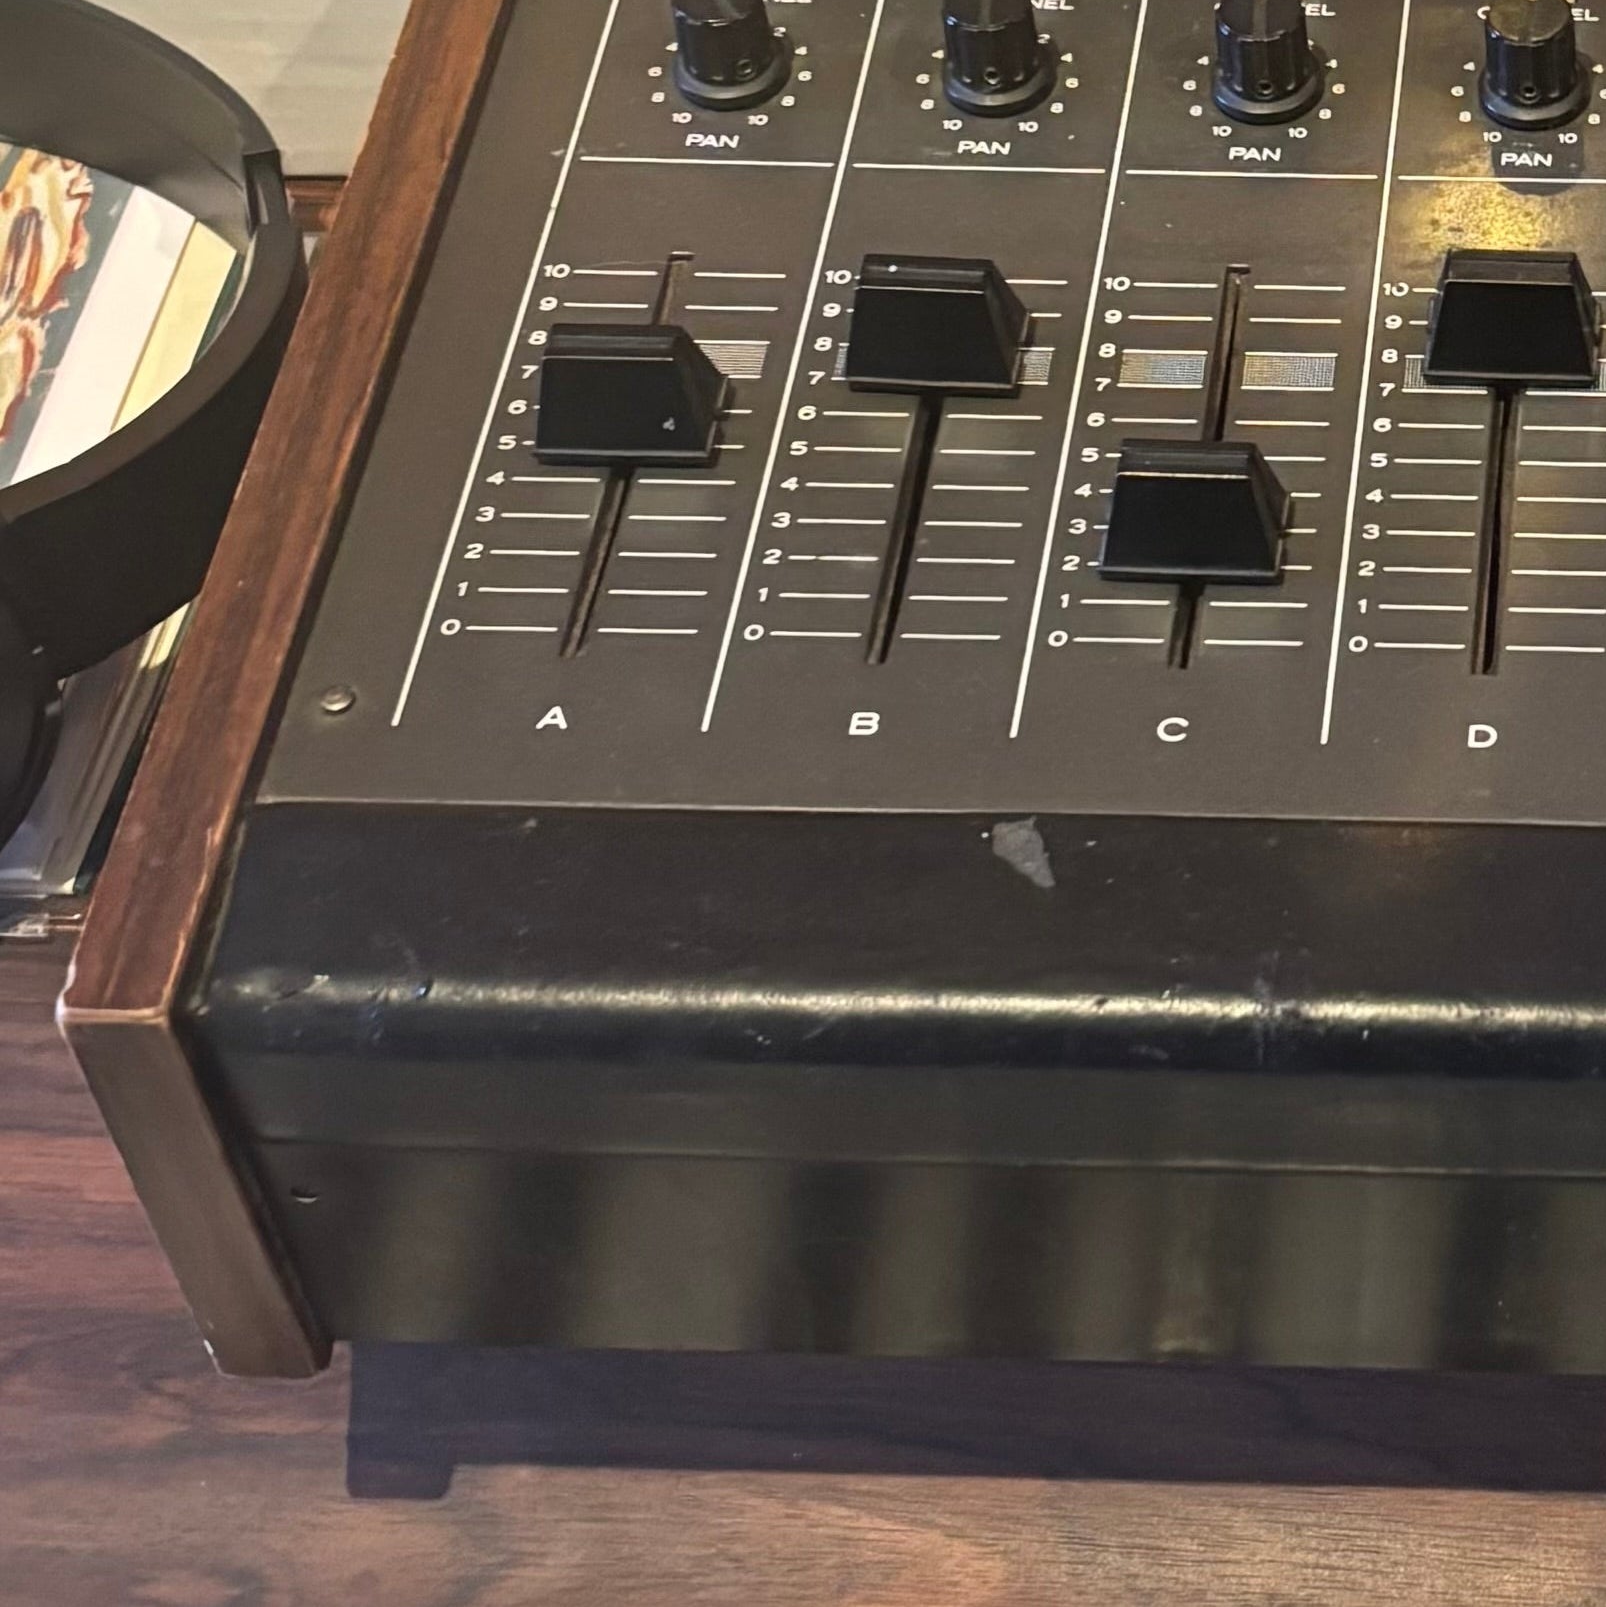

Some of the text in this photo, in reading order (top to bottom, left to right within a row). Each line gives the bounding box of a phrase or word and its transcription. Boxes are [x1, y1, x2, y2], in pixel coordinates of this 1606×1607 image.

[671, 112, 693, 123] 10
[748, 114, 768, 126] 10
[685, 134, 740, 148] PAN
[1482, 131, 1502, 143] 10
[1559, 132, 1578, 144] 10
[957, 140, 1012, 155] PAN
[1228, 147, 1282, 162] PAN
[1500, 153, 1553, 168] PAN
[1102, 276, 1131, 291] 10
[1103, 310, 1123, 324] 9
[1098, 343, 1117, 357] 8
[1095, 378, 1112, 391] 7
[1086, 413, 1106, 427] 6
[1080, 448, 1100, 462] 5
[1073, 485, 1093, 498] 4
[1068, 520, 1088, 534] 3
[1061, 556, 1081, 571] 2
[1060, 594, 1071, 608] 1
[1047, 630, 1068, 647] 0
[535, 705, 568, 730] A
[848, 712, 880, 735] B
[1156, 717, 1190, 742] C
[1467, 724, 1498, 748] D
